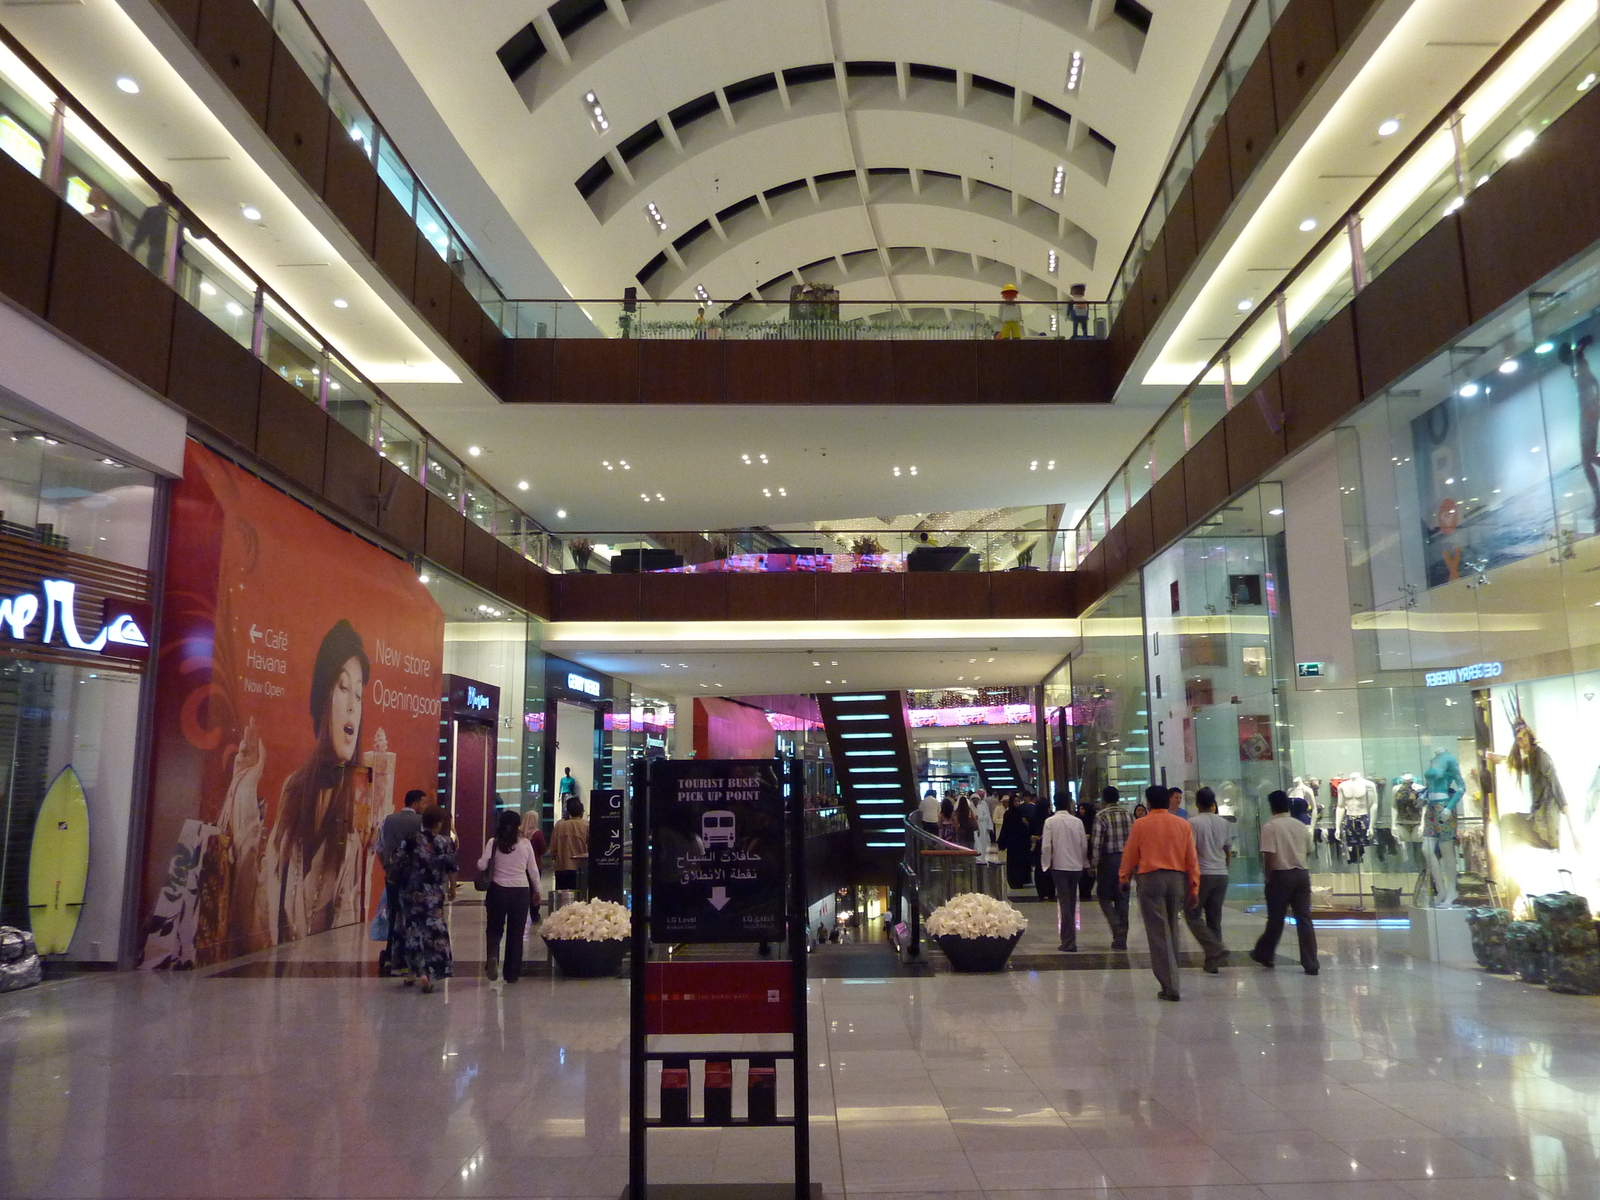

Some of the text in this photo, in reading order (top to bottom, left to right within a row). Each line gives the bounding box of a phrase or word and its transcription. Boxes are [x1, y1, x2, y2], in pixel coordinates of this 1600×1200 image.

[264, 628, 289, 651] Café
[246, 648, 287, 675] Havana
[375, 638, 431, 678] New store
[244, 677, 286, 699] Now Open
[677, 777, 761, 789] TOURIST BUSES
[609, 794, 621, 809] G
[677, 790, 761, 802] PICK UP POINT
[675, 849, 762, 869] حافلات السياح
[680, 867, 758, 885] نقطة الانطلاق
